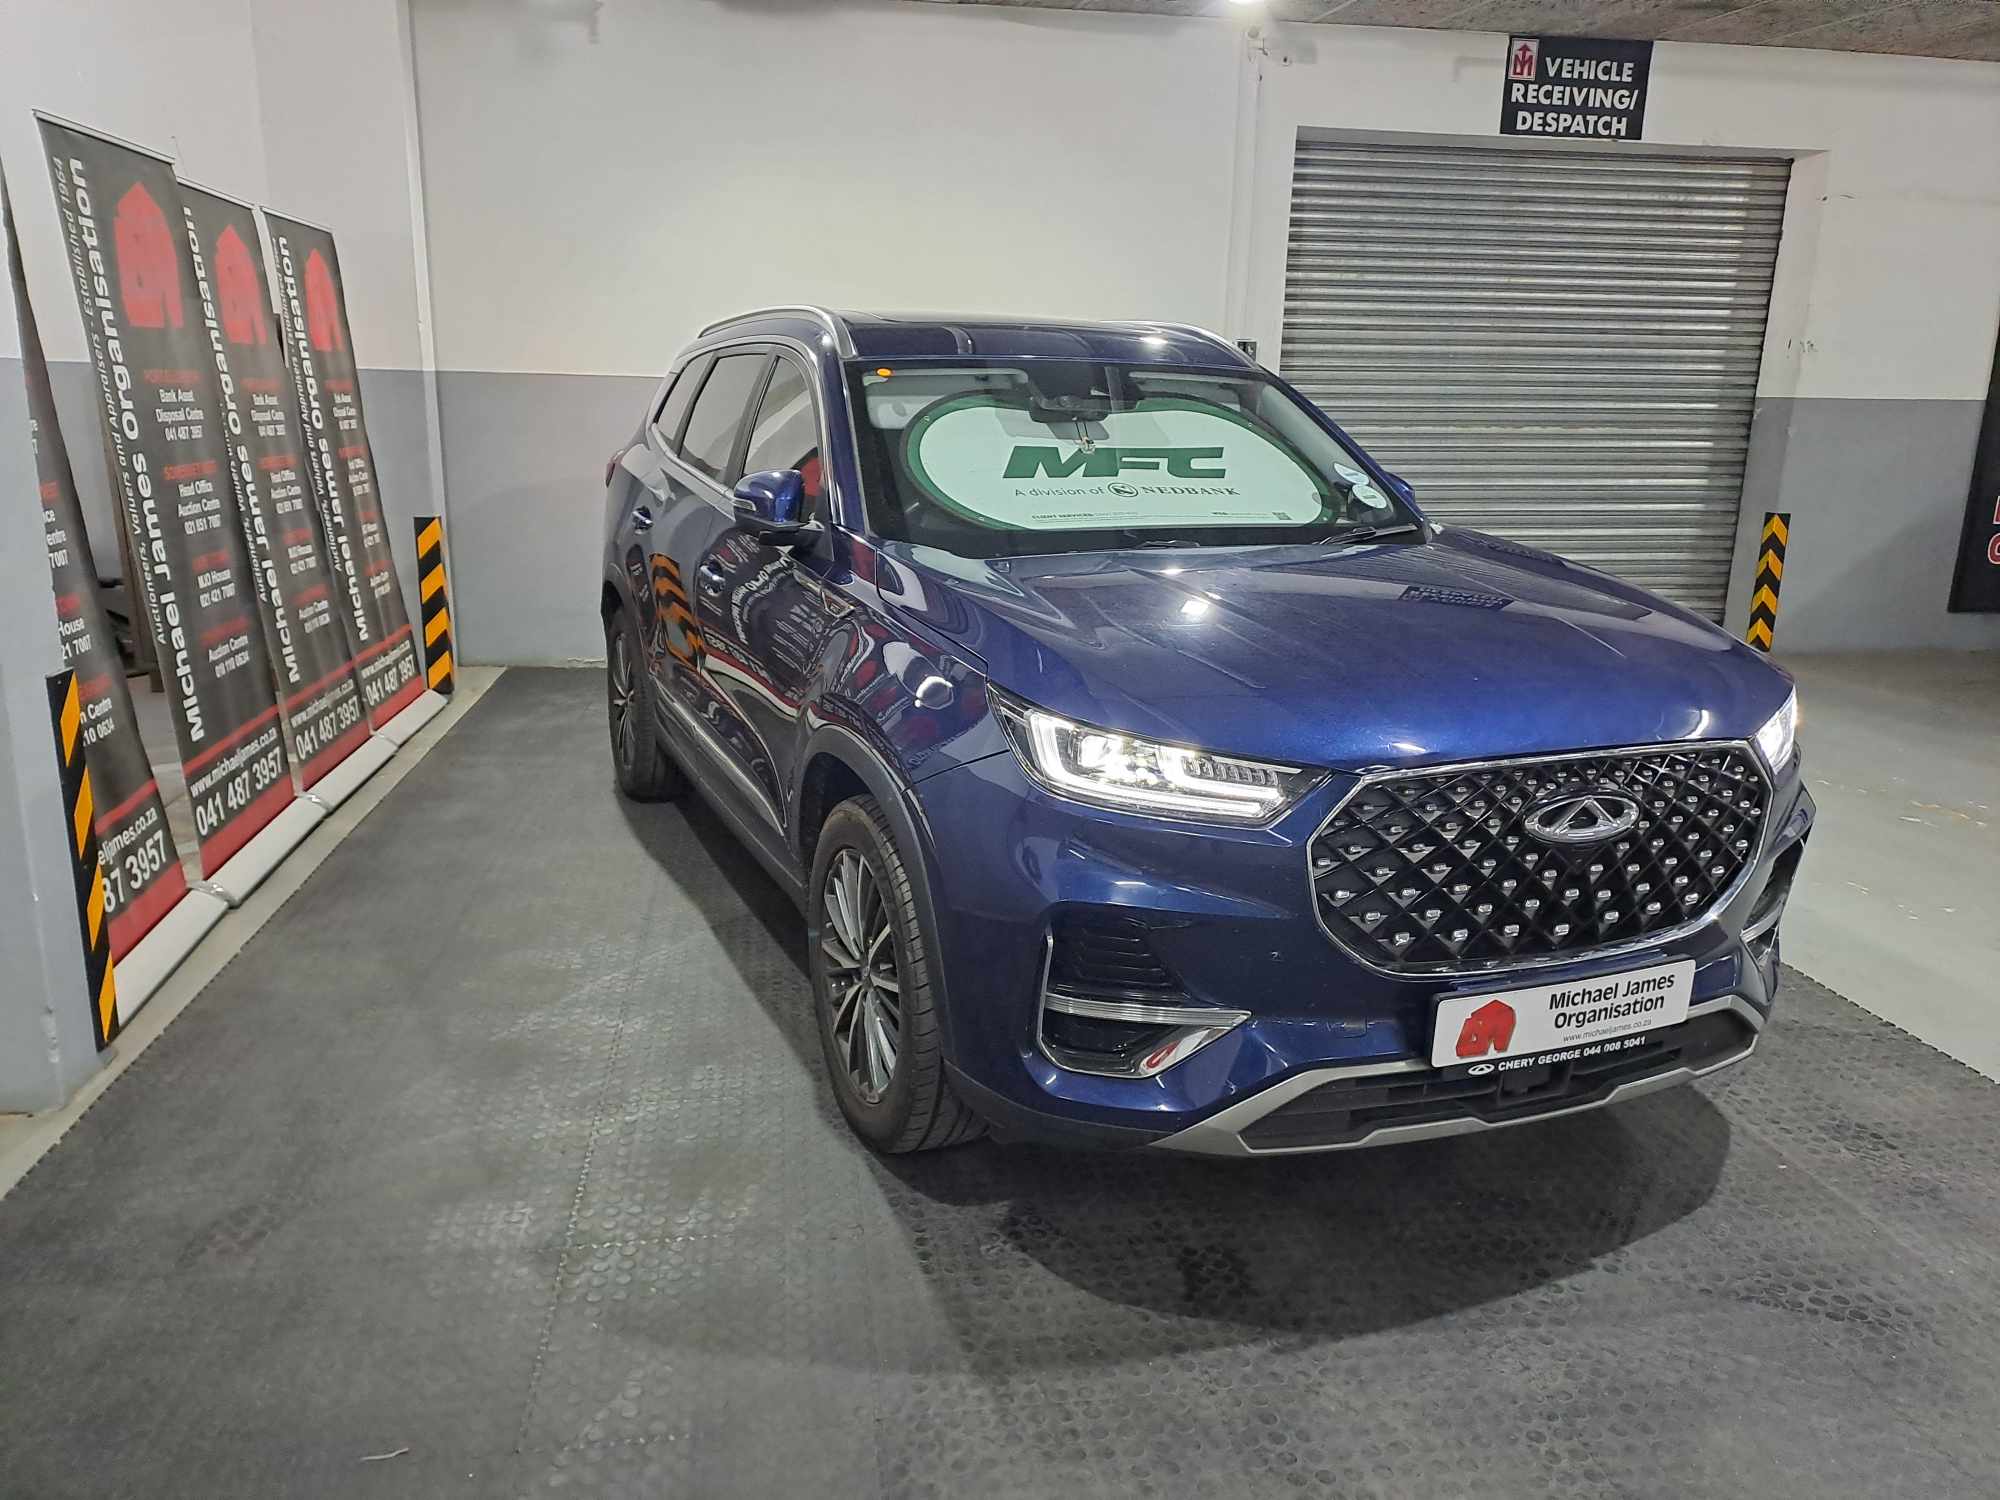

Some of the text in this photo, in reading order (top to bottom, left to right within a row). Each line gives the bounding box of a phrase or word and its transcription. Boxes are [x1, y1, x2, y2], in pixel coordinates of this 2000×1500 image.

[1511, 82, 1639, 110] RECEIVING/
[1545, 57, 1635, 82] VEHICLE
[1516, 111, 1628, 136] DESPATCH
[63, 208, 94, 316] Established
[278, 236, 324, 430] Organisation
[92, 333, 120, 431] Appraisers
[69, 157, 205, 742] Michael James Organisation
[112, 432, 127, 467] and
[1002, 446, 1226, 479] MFC
[122, 471, 141, 535] Valuers
[237, 444, 270, 551] James
[318, 437, 344, 528] James
[1014, 486, 1242, 497] A division of NEDBANK
[47, 528, 66, 546] entre
[337, 535, 369, 642] Michael
[261, 559, 300, 684] Michael
[365, 677, 385, 706] 041
[384, 666, 400, 694] 487
[83, 727, 97, 747] 10
[295, 695, 360, 761] 041 487 3957
[195, 746, 282, 836] 041 487 3957
[97, 807, 158, 865] eljames.co.za
[102, 829, 166, 912] 87 3957
[1549, 974, 1676, 1010] Michael James
[1554, 995, 1665, 1029] Organisation
[1498, 1057, 1535, 1071] CHERY
[1537, 1049, 1582, 1065] GEORGE
[1603, 1041, 1621, 1054] 008
[1622, 1036, 1646, 1049] 5041
